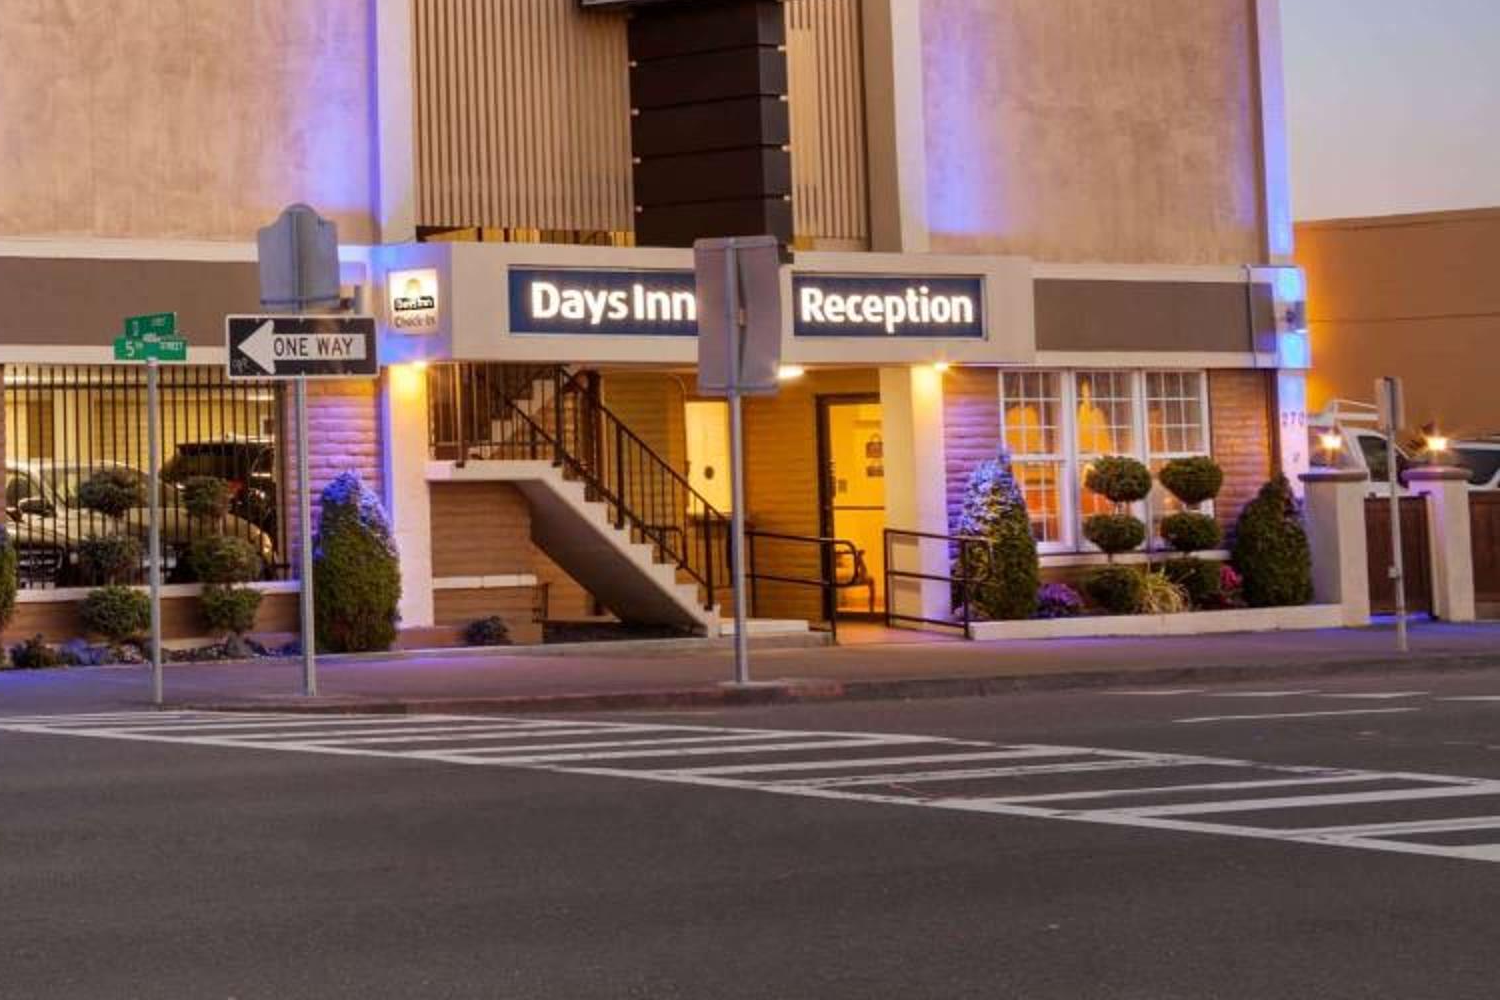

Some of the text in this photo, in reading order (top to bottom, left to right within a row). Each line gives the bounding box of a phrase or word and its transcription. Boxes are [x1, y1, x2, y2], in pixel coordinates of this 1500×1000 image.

[531, 282, 697, 325] Days Inn
[801, 287, 974, 334] Reception
[273, 337, 353, 357] ONE WAY
